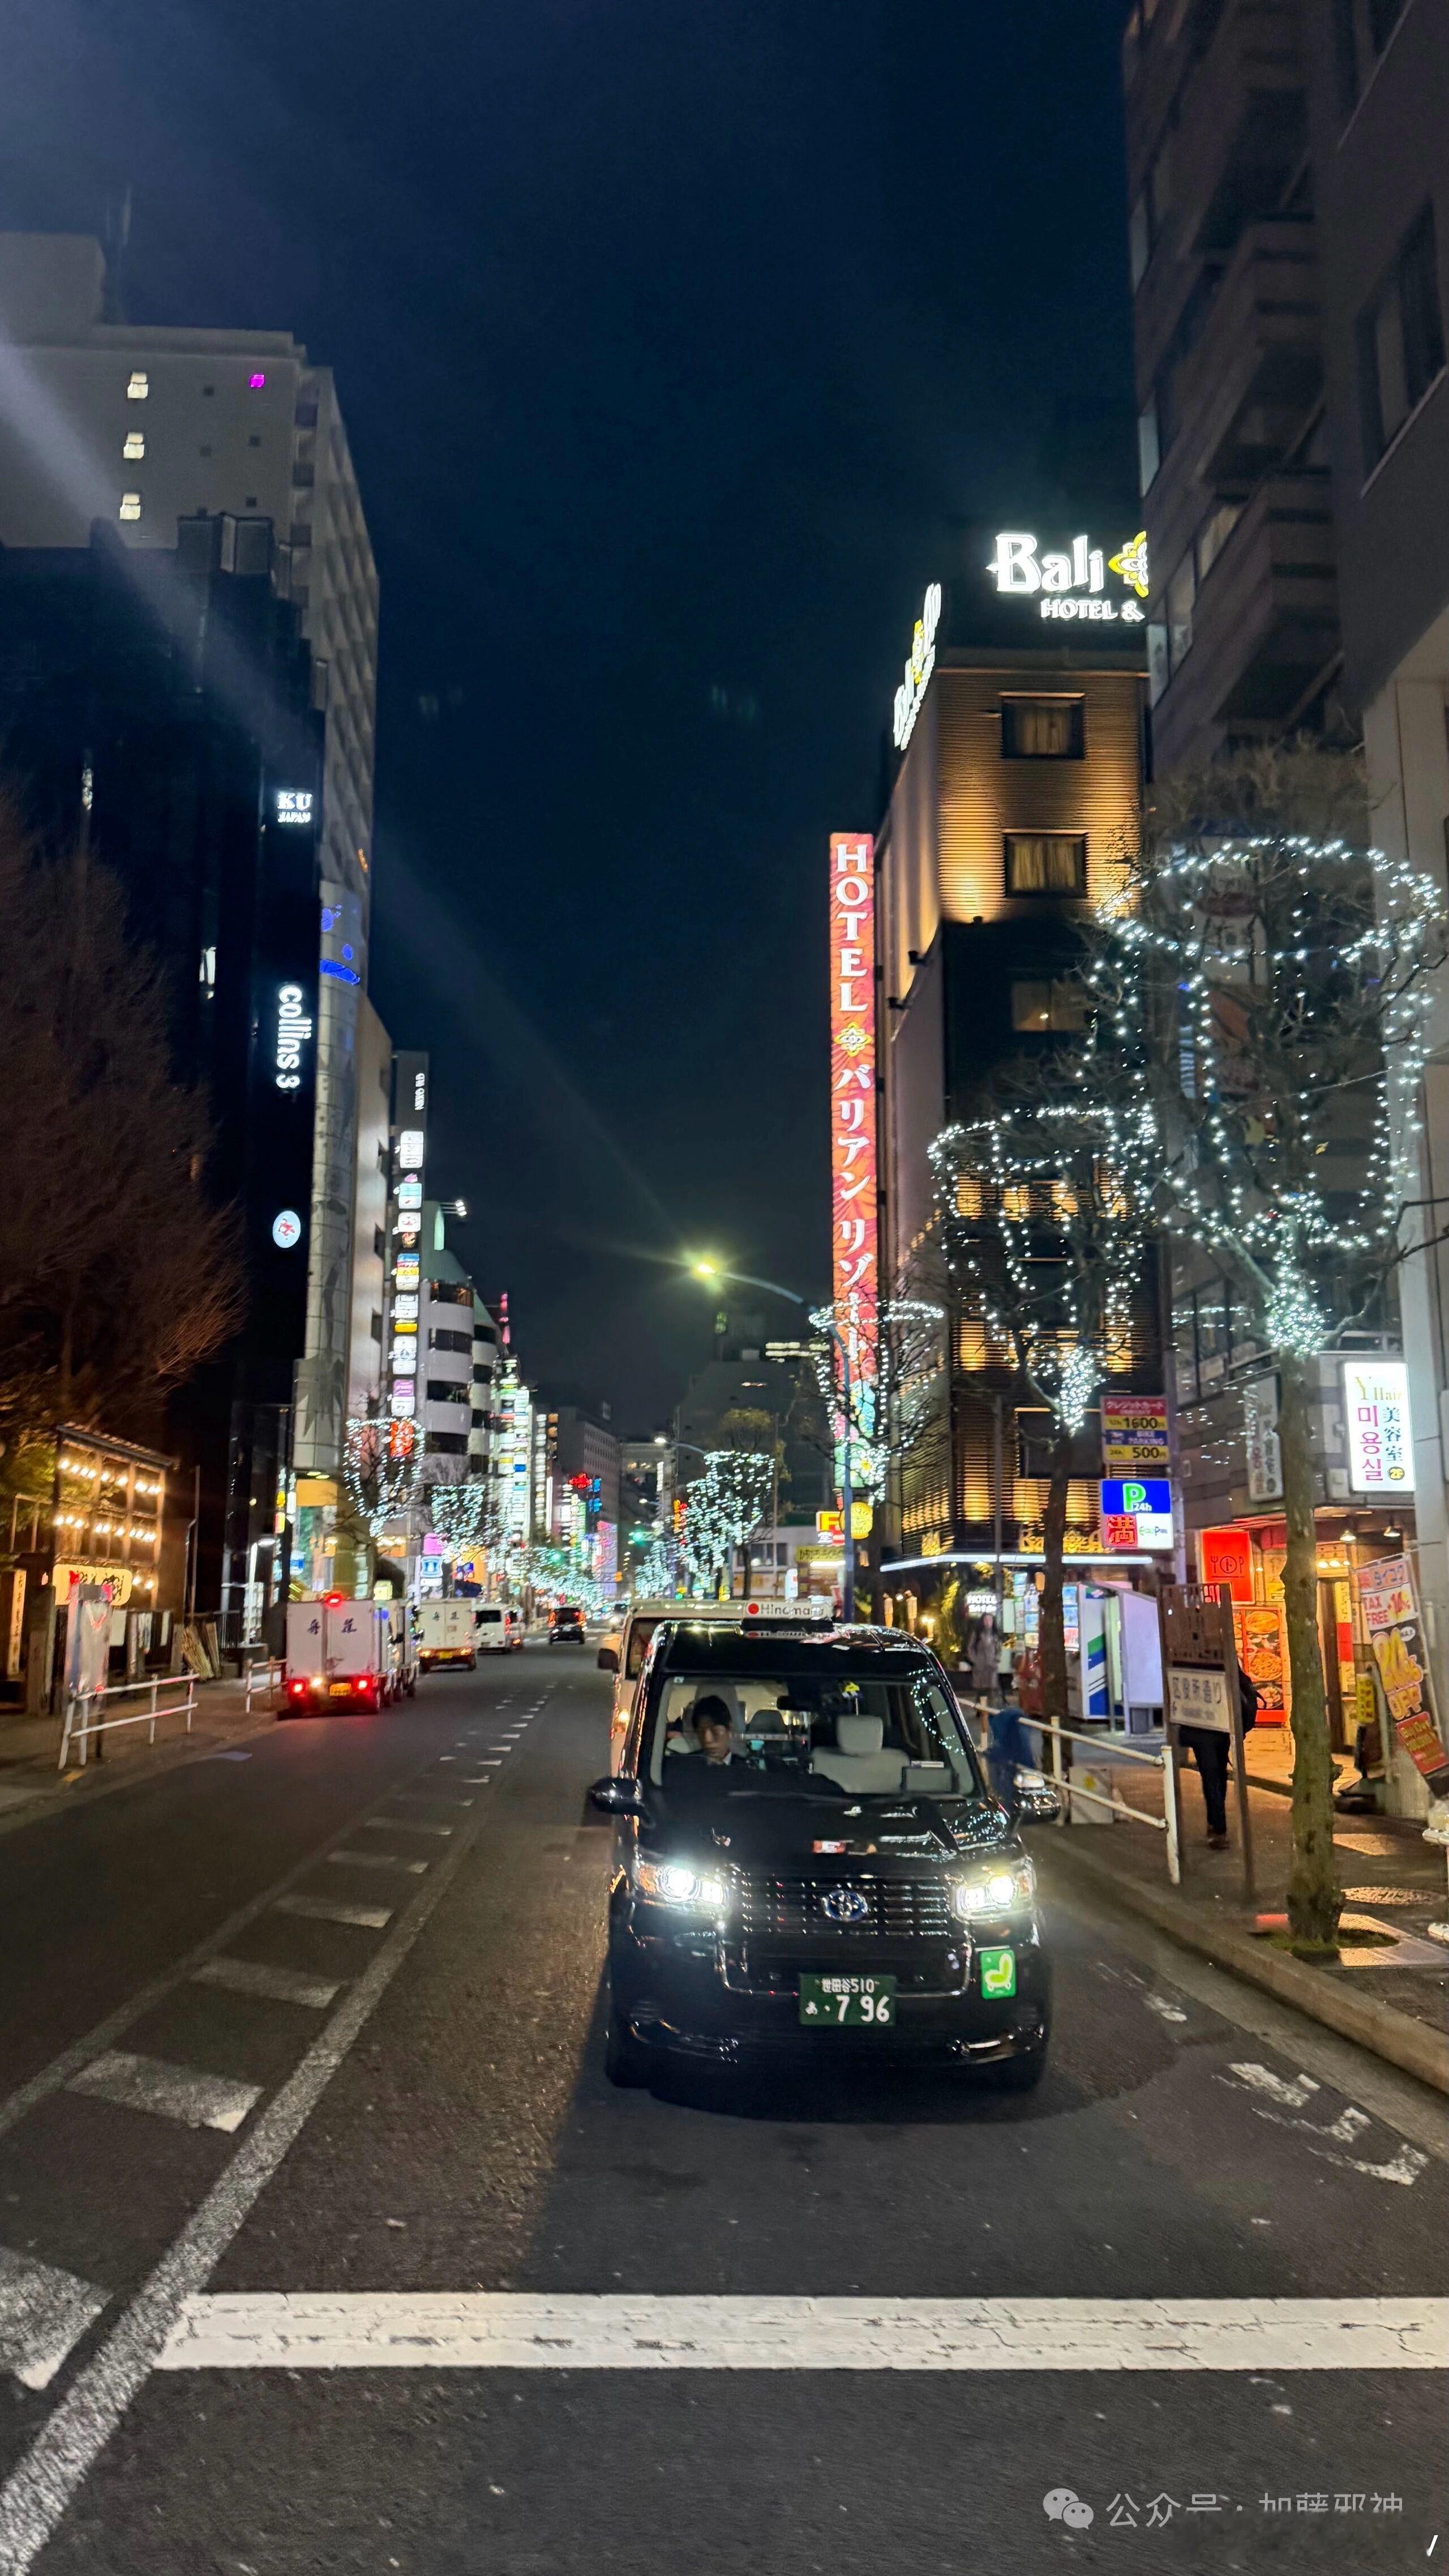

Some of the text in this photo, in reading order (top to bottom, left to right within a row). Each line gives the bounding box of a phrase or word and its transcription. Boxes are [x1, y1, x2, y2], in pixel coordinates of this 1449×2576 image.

[985, 533, 1105, 594] Bali
[1040, 598, 1146, 623] HOTEL &
[277, 792, 312, 810] KU
[835, 843, 869, 1012] HOTEL
[276, 985, 312, 1088] collins 3
[1357, 1405, 1383, 1481] 미용실
[1382, 1407, 1404, 1461] 美容室
[1132, 1447, 1159, 1459] 500
[1123, 1483, 1152, 1512] P 24h
[1108, 1515, 1135, 1544] 満
[1362, 1595, 1382, 1610] TAX
